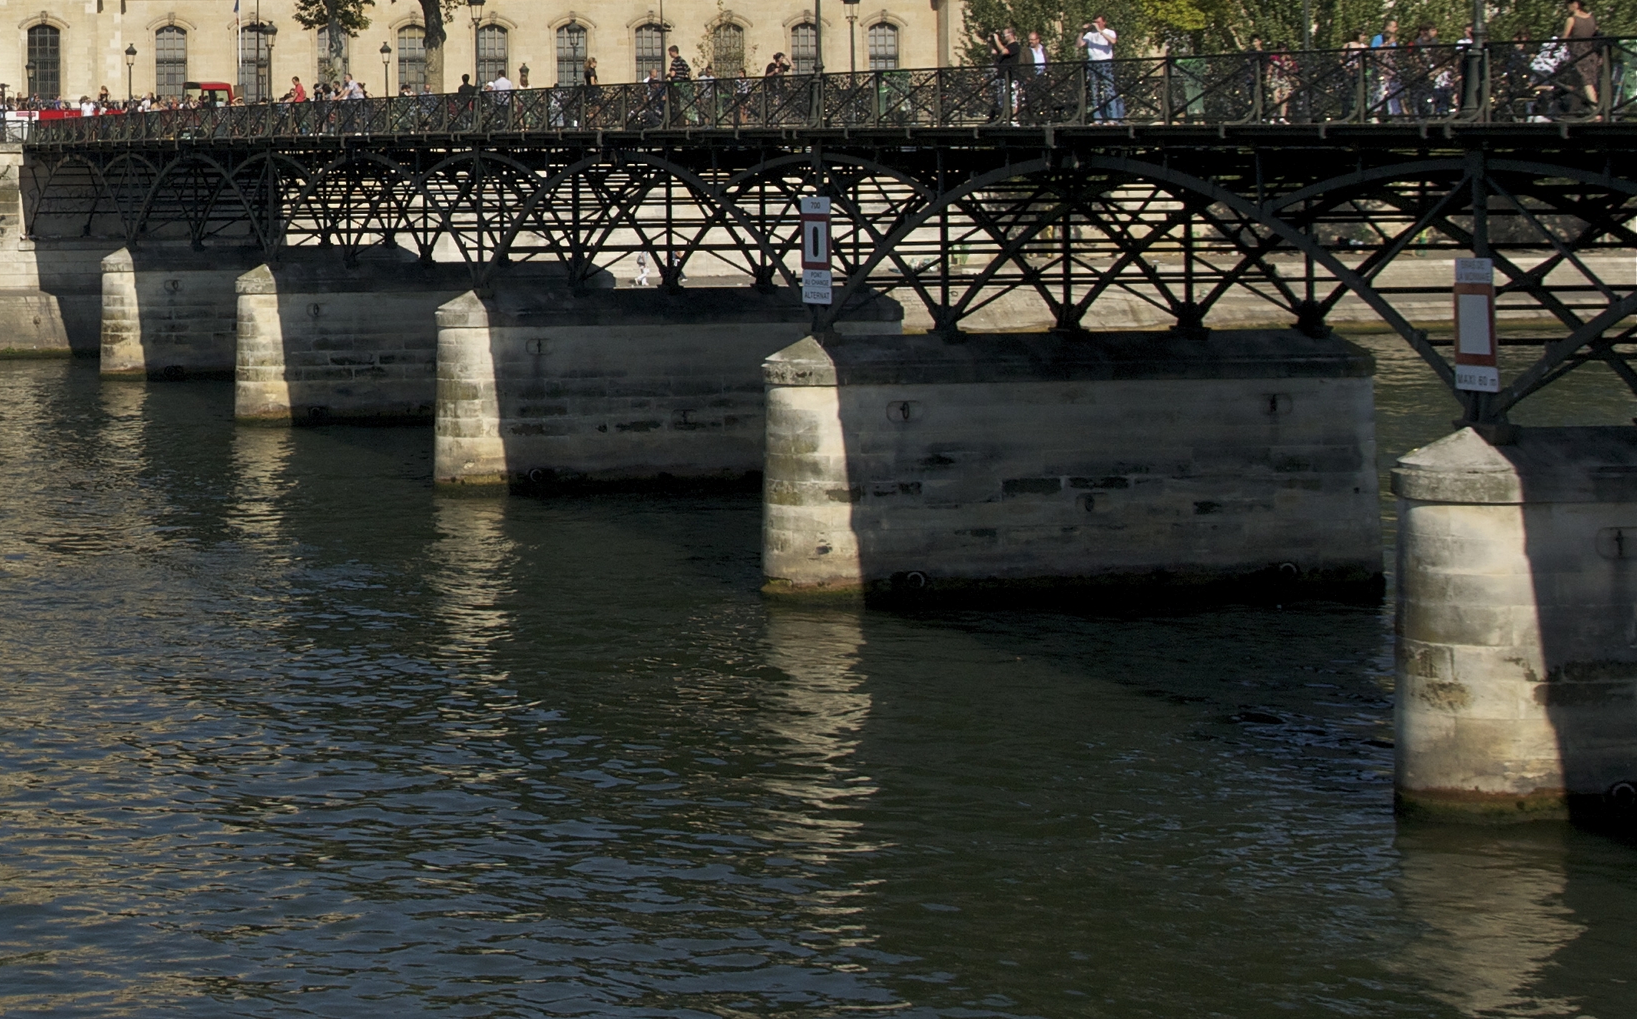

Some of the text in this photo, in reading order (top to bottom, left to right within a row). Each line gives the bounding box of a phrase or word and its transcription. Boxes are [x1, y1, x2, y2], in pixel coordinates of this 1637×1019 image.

[810, 201, 821, 210] 700
[810, 271, 822, 279] PONT
[811, 279, 829, 287] CHANGE
[804, 291, 830, 300] ALTERNAT
[1457, 373, 1476, 385] MAXI
